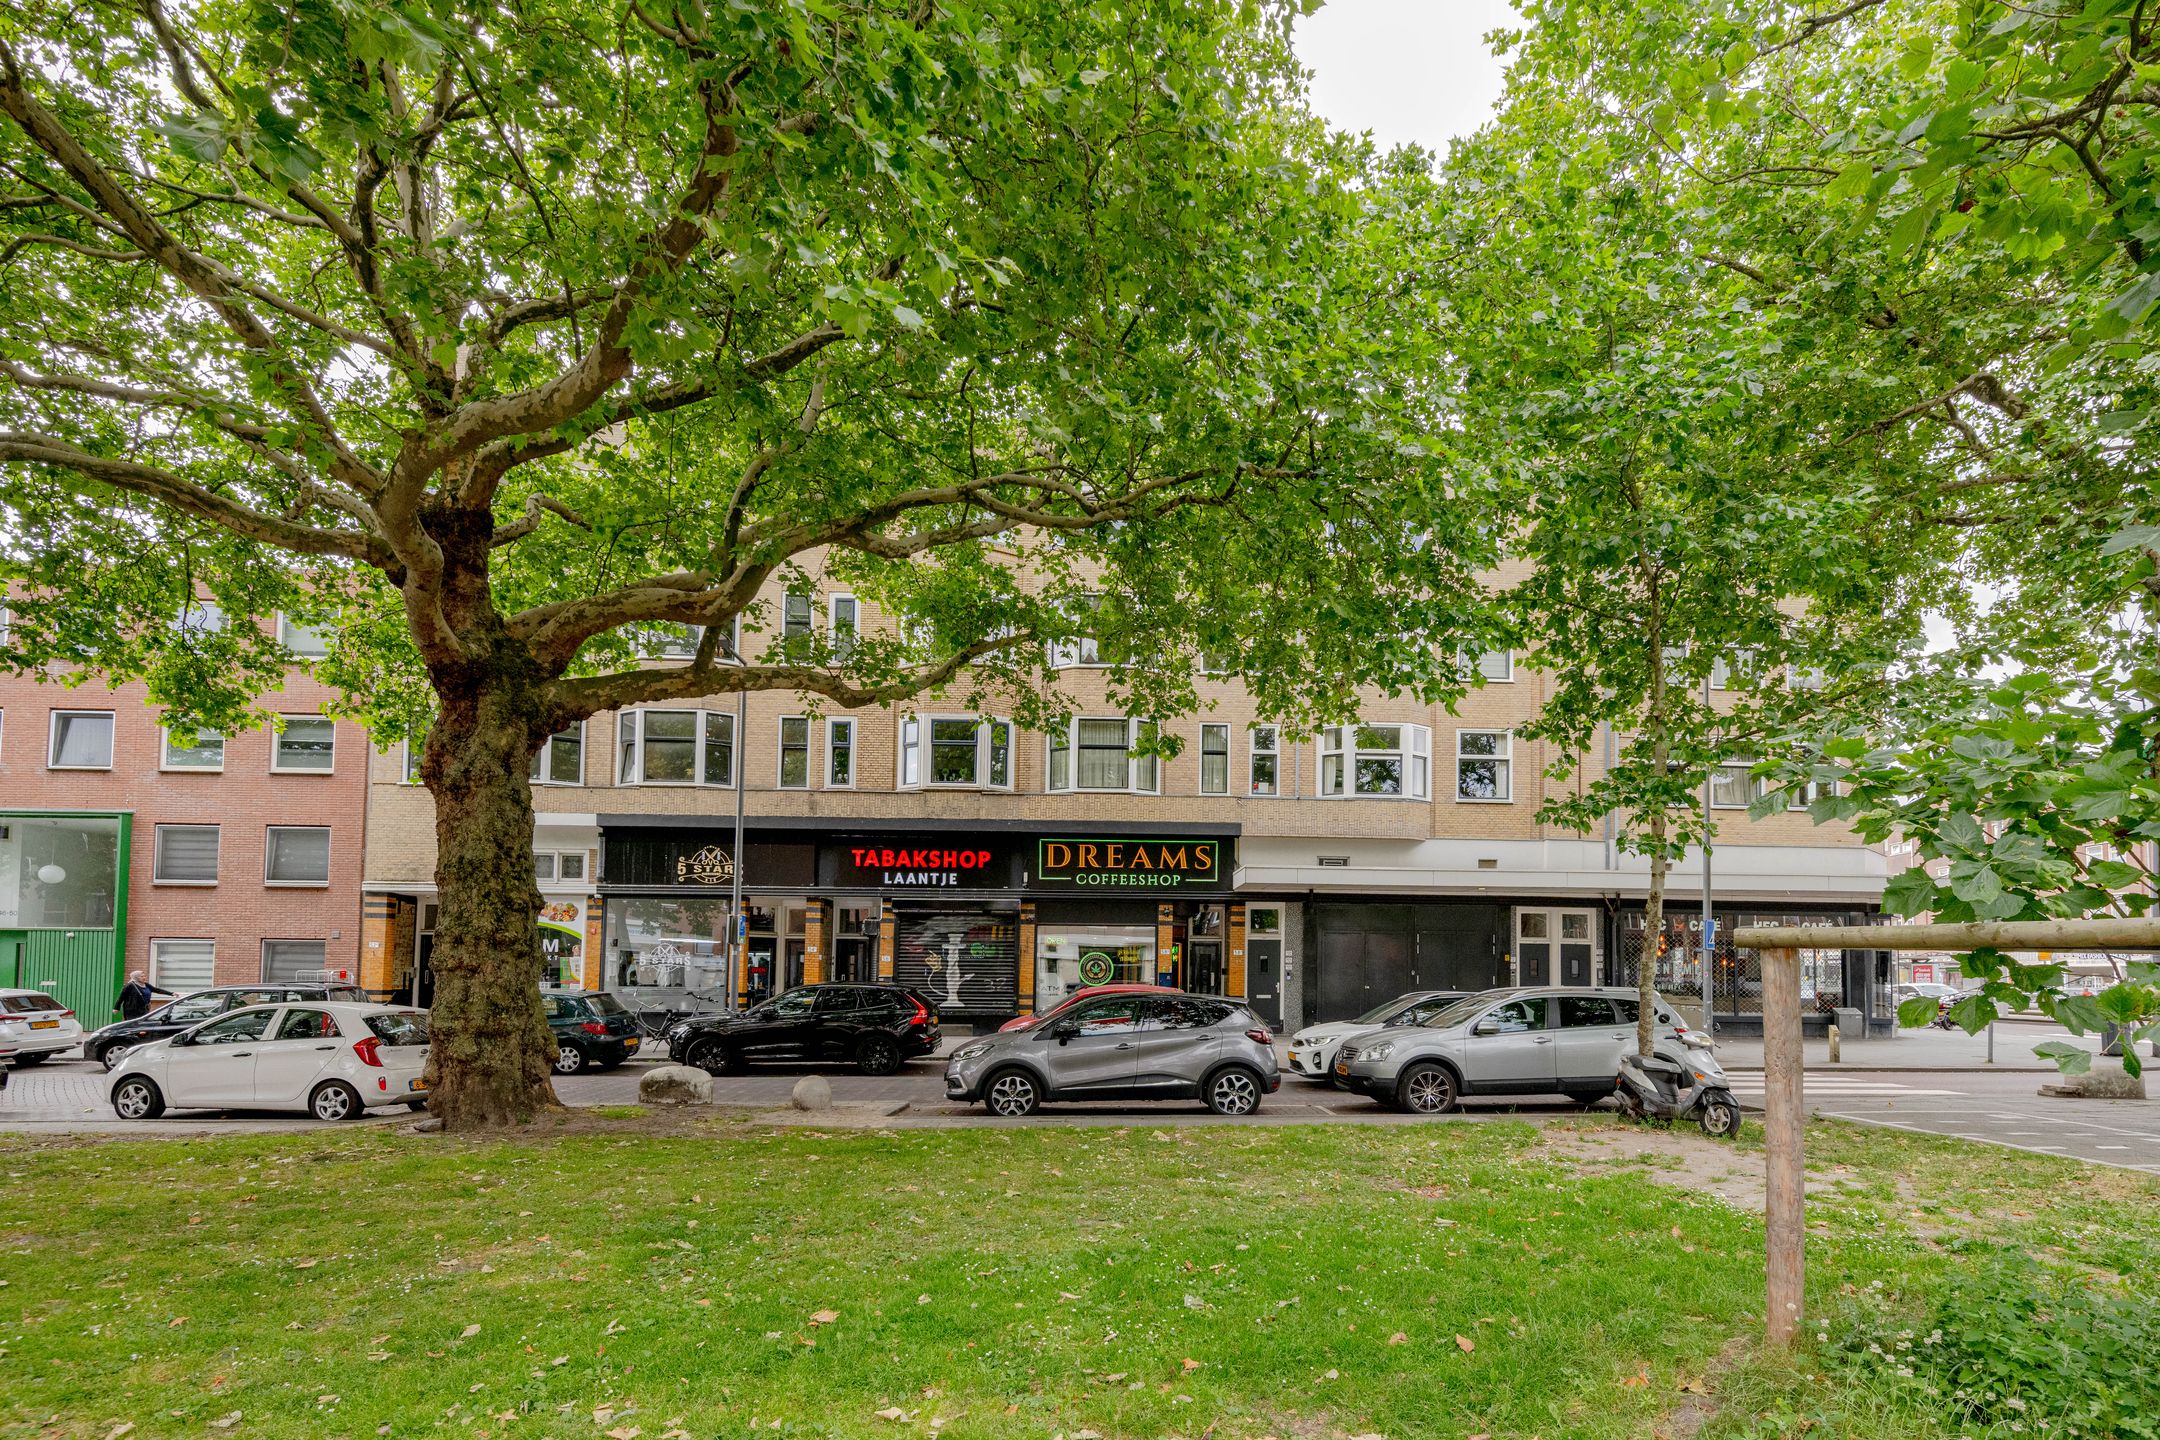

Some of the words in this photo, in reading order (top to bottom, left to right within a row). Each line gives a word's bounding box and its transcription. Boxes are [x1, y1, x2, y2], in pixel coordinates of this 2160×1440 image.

[851, 849, 992, 869] TABAKSHOP
[1045, 843, 1212, 870] DREAMS
[677, 862, 687, 875] 5
[693, 864, 744, 875] STAR
[884, 872, 958, 887] LAANTJE
[1075, 873, 1182, 886] COFFEESHOP
[1689, 917, 1722, 932] CAÉ
